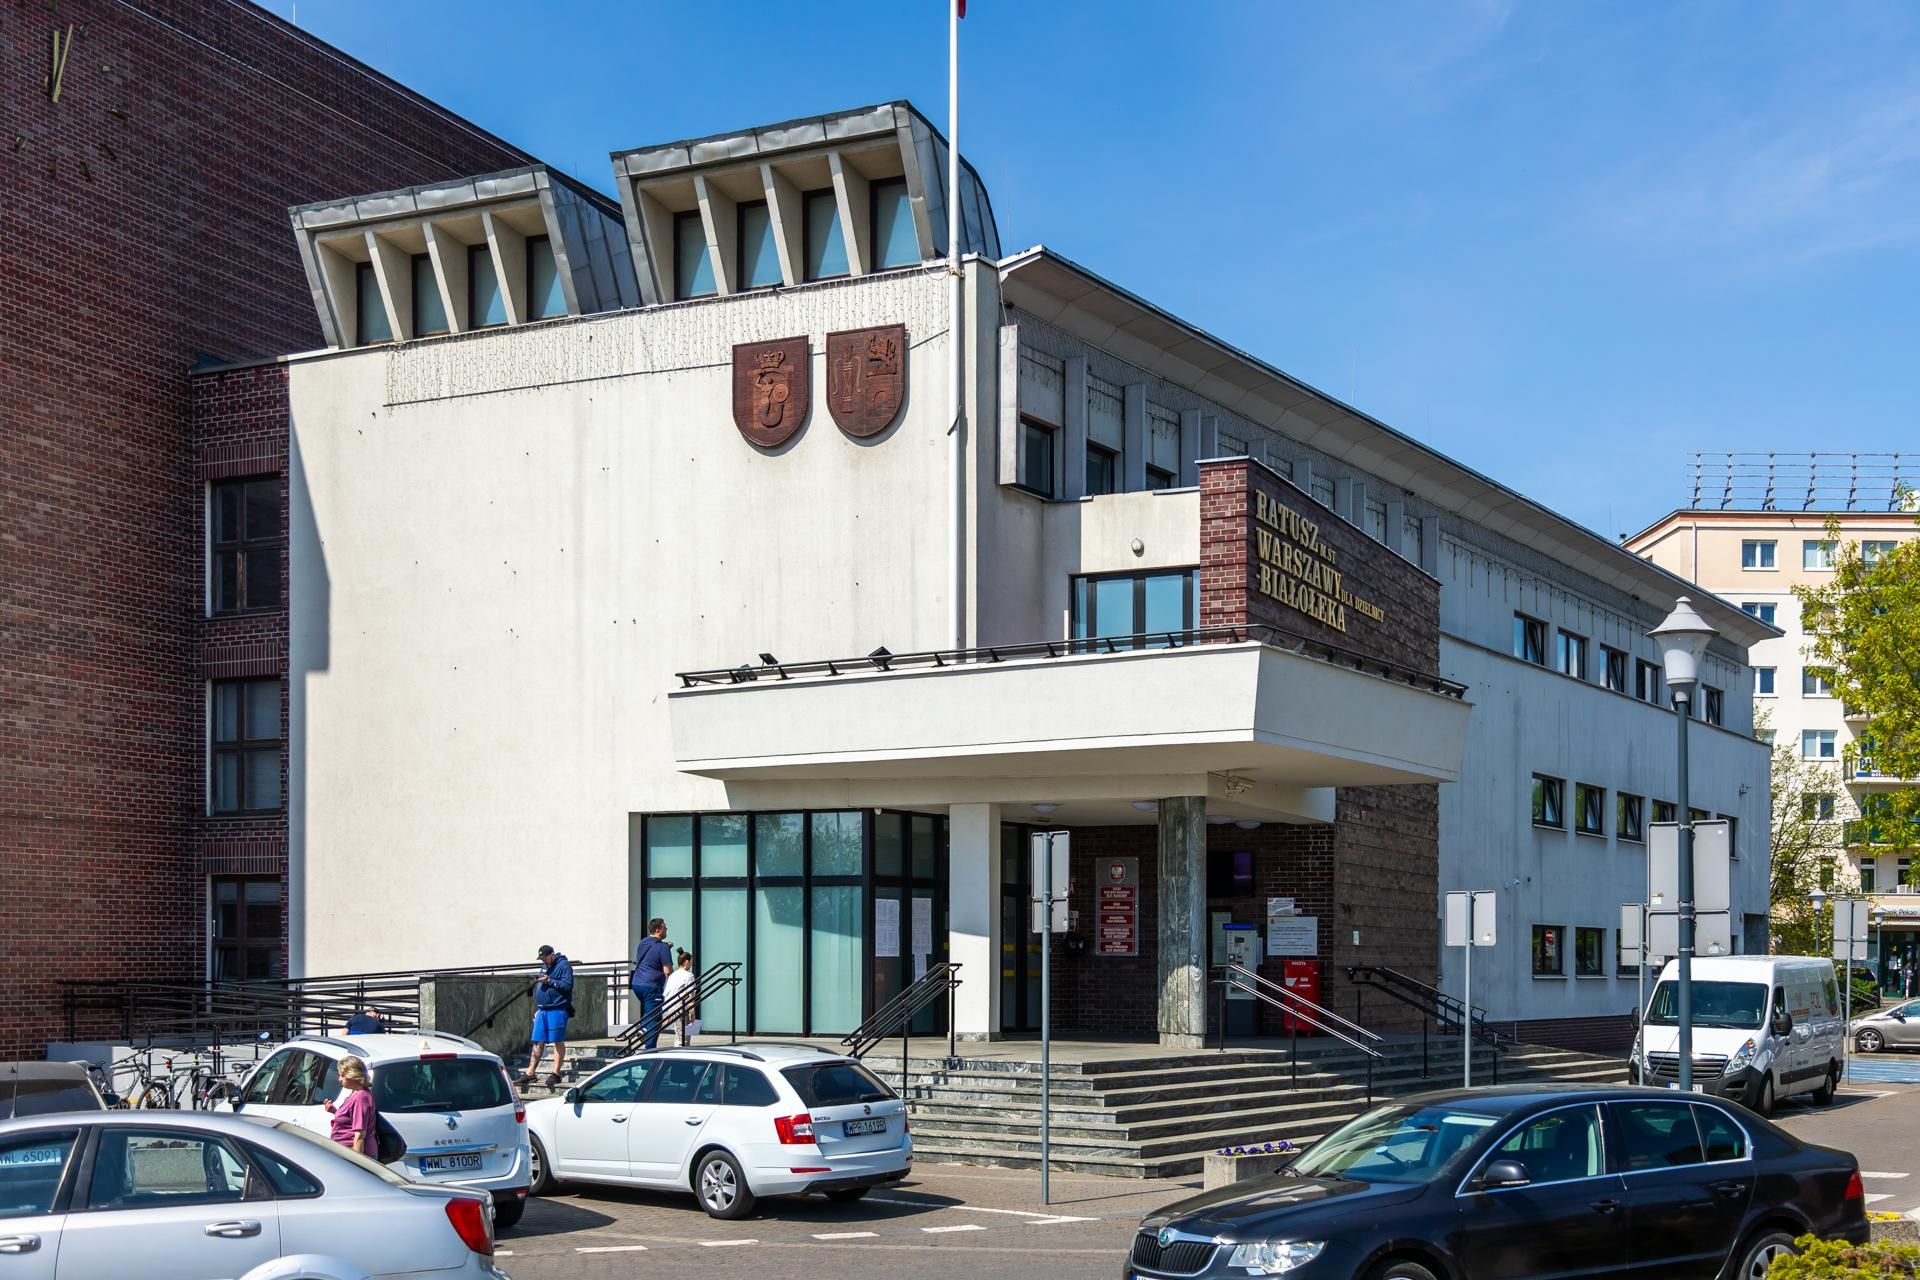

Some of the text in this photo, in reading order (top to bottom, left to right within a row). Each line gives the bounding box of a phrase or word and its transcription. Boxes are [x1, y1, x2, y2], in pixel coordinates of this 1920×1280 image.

[1256, 489, 1319, 553] RATUSZ
[1256, 527, 1385, 623] WARSZAWY DLA DZIELNICY
[434, 1137, 471, 1146] SCENIC
[23, 1150, 58, 1164] 6509T
[426, 1155, 480, 1170] WWL 8100R
